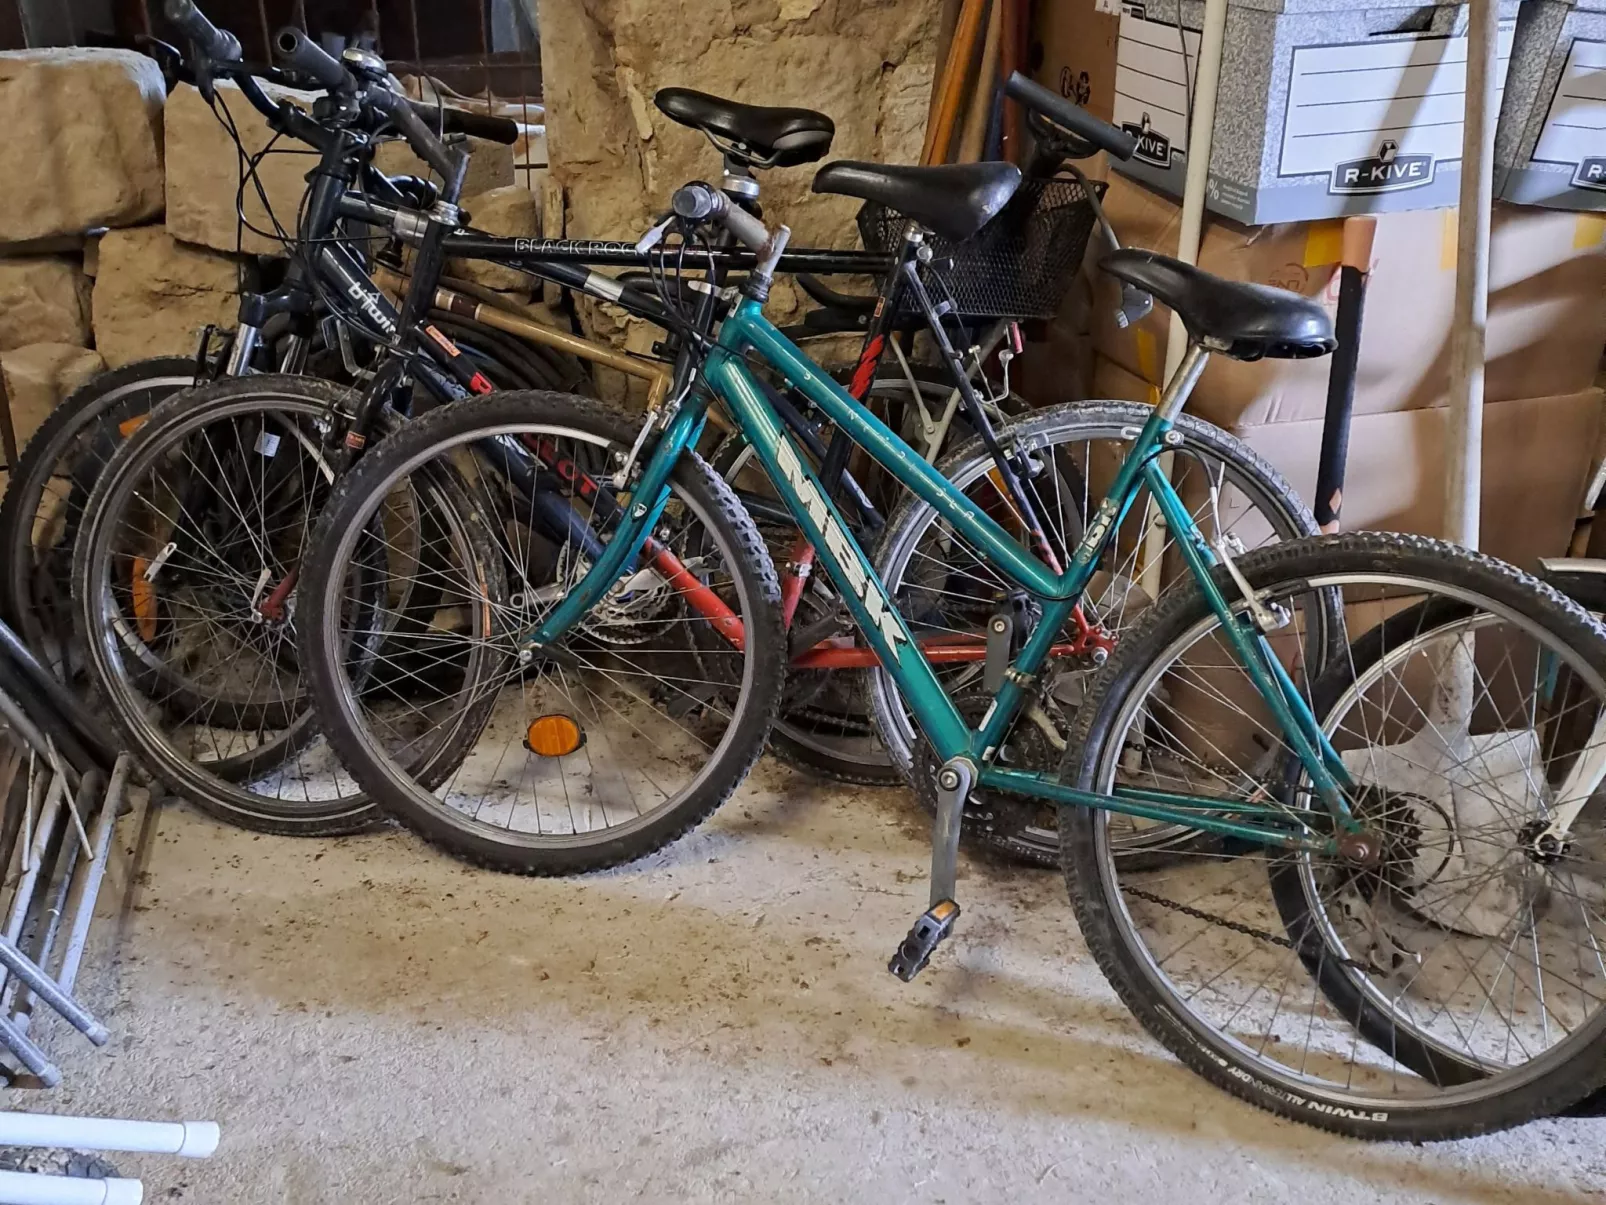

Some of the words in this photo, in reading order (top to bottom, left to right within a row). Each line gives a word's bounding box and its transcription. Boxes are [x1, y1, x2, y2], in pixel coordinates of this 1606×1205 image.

[1125, 129, 1165, 157] KIVE
[1344, 161, 1423, 184] R-KIVE
[514, 238, 584, 254] BLACK
[588, 240, 646, 257] ROC
[775, 434, 907, 667] MBK
